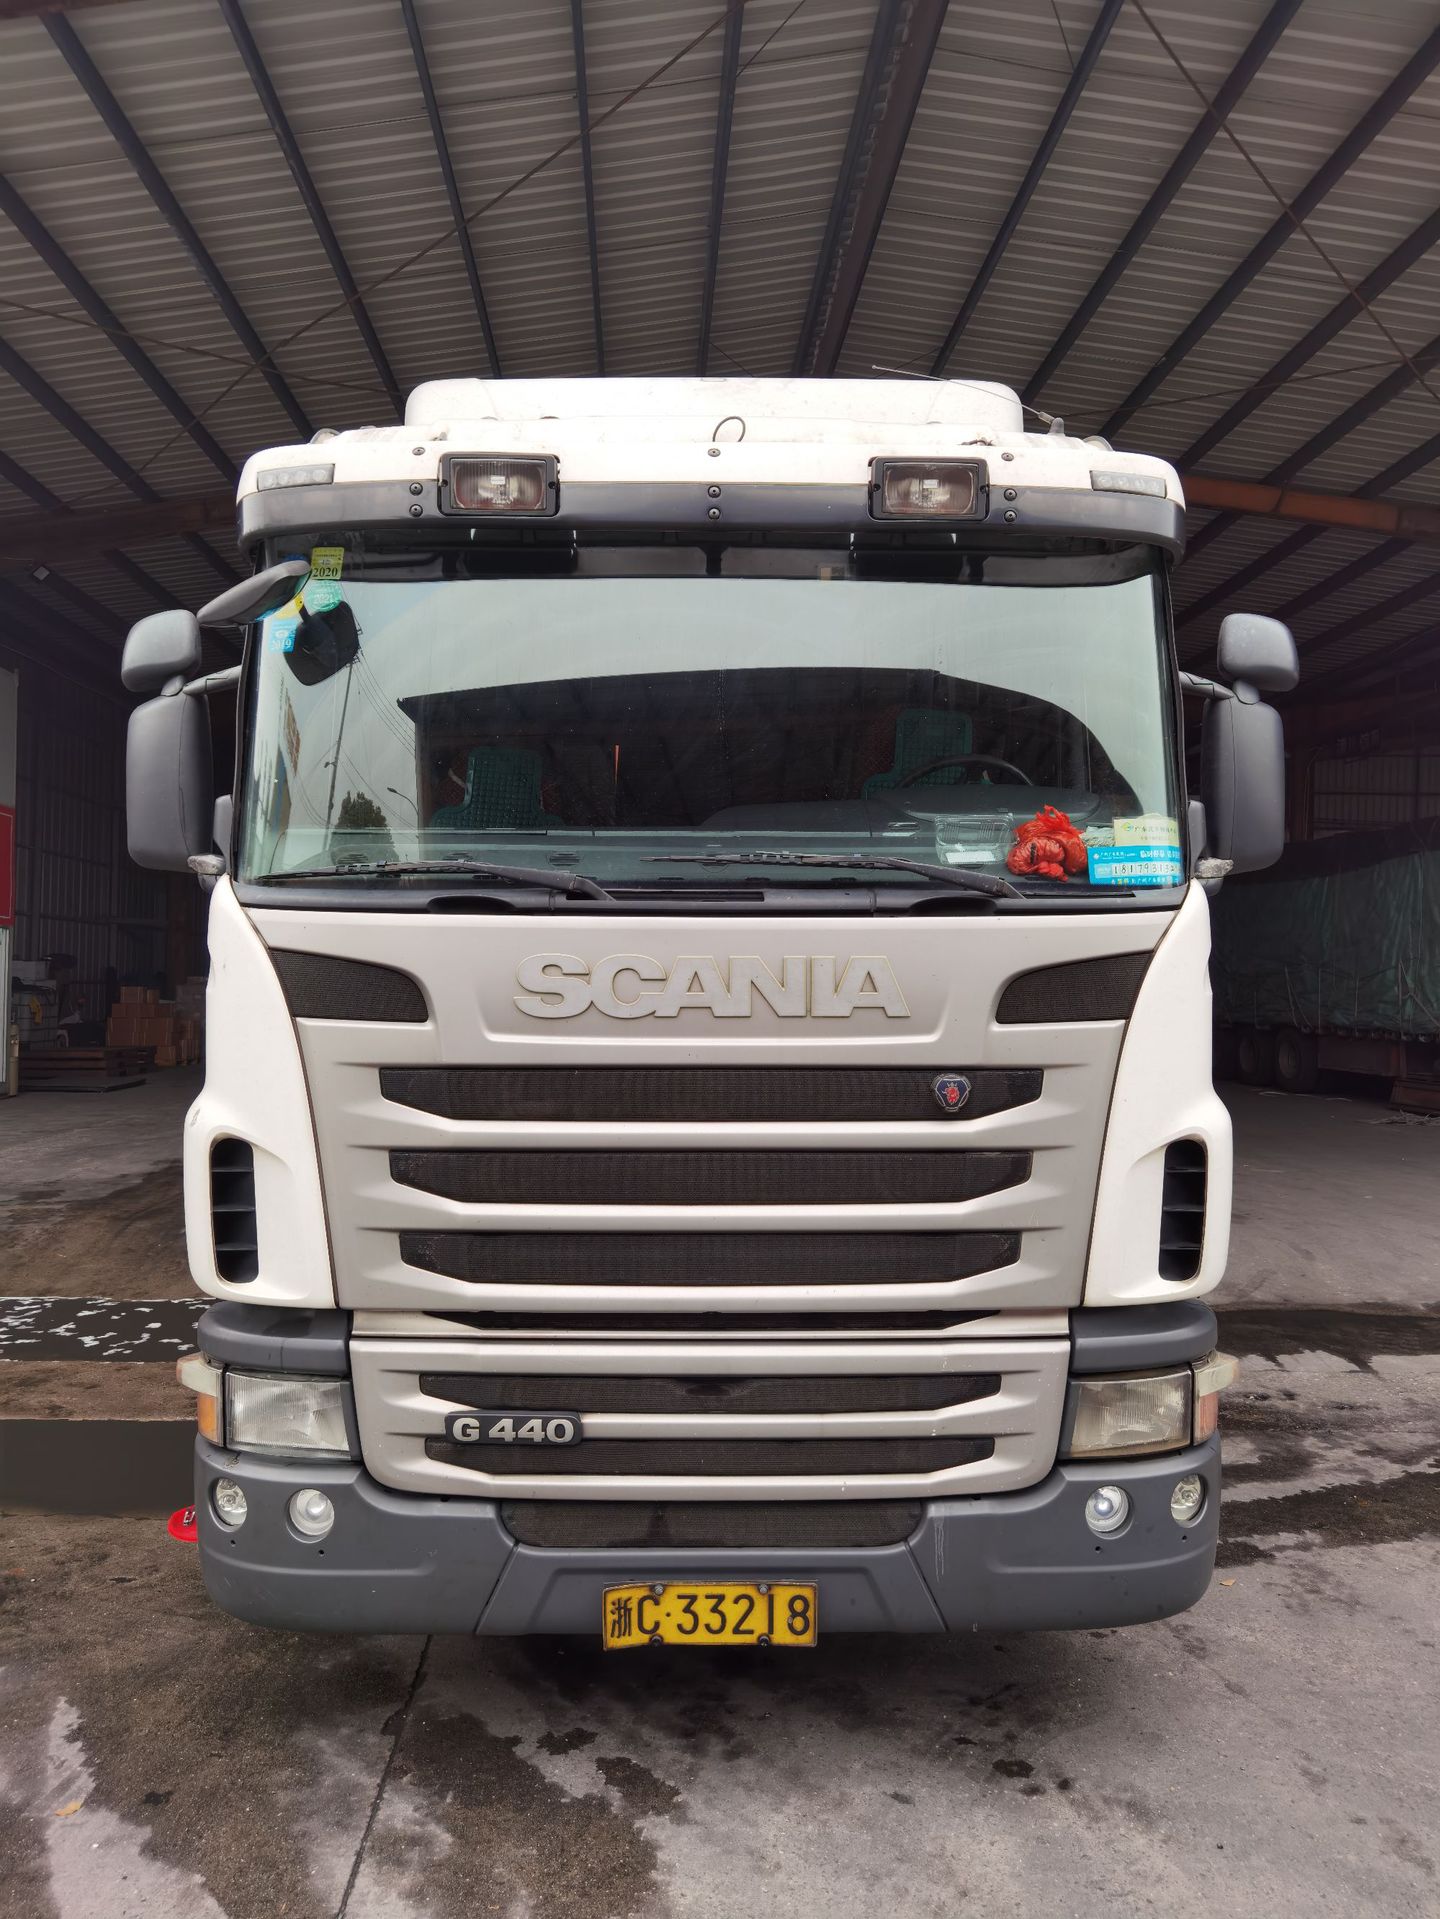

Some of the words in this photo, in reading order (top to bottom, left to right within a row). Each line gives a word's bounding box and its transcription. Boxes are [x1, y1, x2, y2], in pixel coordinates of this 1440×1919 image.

[312, 567, 338, 577] 2020
[513, 953, 911, 1018] SCANIA
[453, 1417, 480, 1442] G
[488, 1418, 575, 1443] 440
